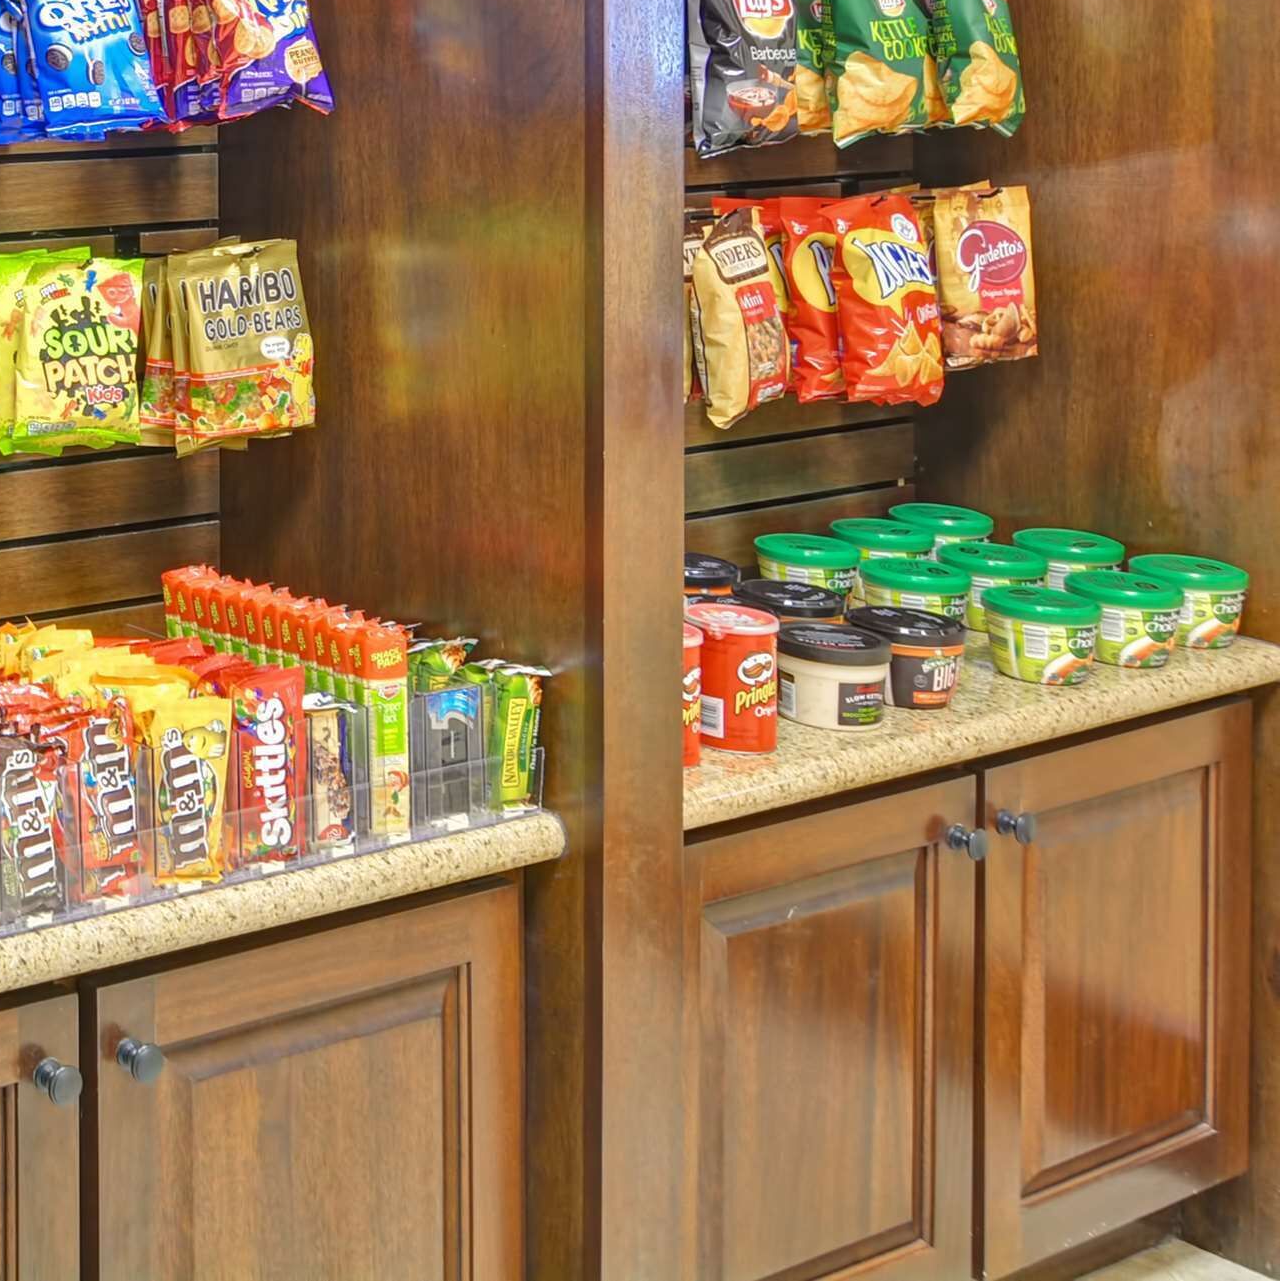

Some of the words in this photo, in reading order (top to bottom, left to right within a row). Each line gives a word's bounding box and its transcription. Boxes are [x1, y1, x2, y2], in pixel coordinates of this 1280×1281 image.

[869, 17, 917, 41] KETTLE
[749, 45, 797, 63] Barbecue
[955, 228, 1025, 294] Gardetto's
[198, 268, 296, 313] HARIBO
[741, 290, 764, 309] Mini
[204, 306, 302, 341] GOLD-BEARS
[44, 324, 133, 359] SOUR
[44, 353, 137, 393] PATCH
[86, 385, 123, 405] Kids
[370, 646, 402, 662] SNACK
[376, 654, 404, 669] PACK
[932, 661, 956, 692] BIG
[734, 680, 778, 715] Pringle
[510, 700, 525, 740] VALLEY
[504, 739, 518, 785] NATURE
